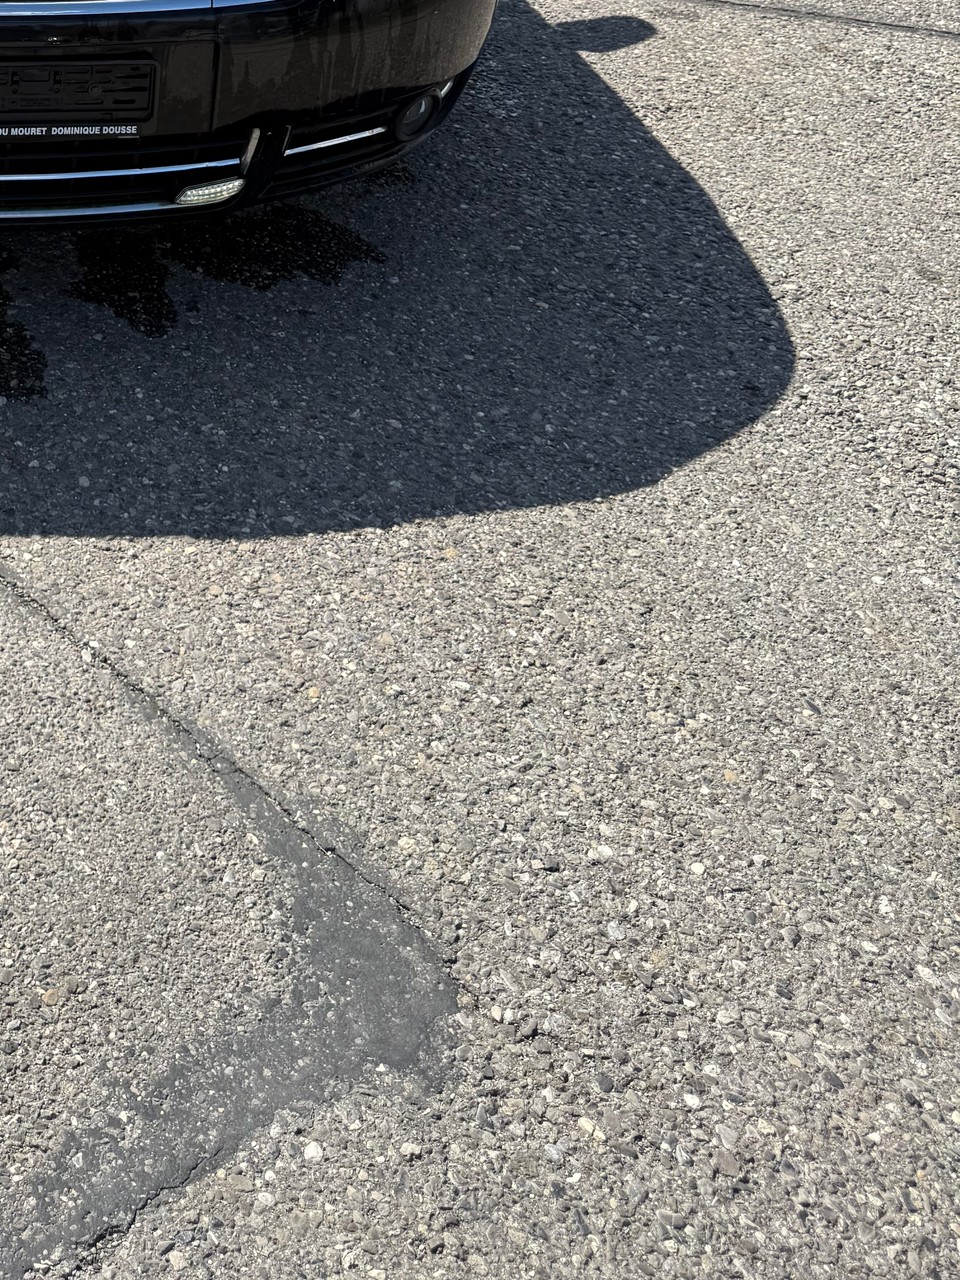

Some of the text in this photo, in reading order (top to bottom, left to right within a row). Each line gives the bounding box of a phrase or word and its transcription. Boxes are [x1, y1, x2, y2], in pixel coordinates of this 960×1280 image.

[10, 126, 48, 136] MOURET
[51, 126, 101, 135] DOMINIQUE
[102, 126, 137, 134] DOUSSE
